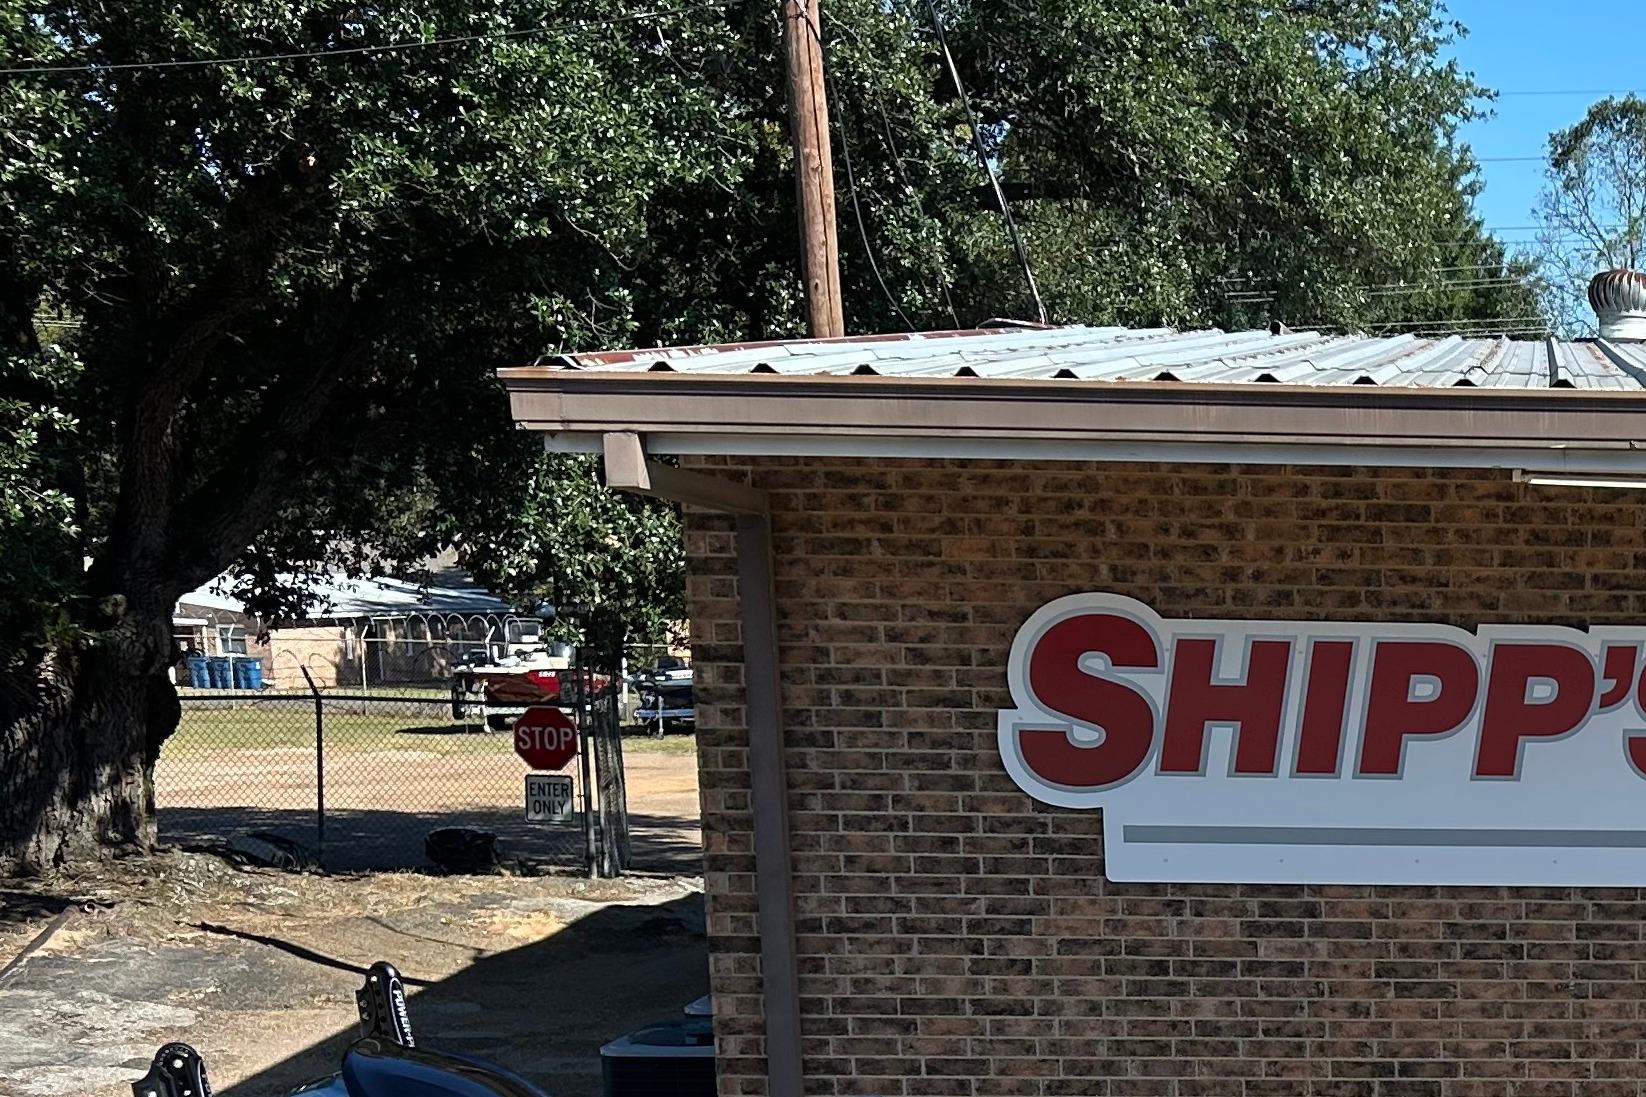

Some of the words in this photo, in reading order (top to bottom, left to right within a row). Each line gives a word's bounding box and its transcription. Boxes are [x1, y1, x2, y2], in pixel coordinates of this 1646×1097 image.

[518, 726, 573, 751] STOP
[529, 782, 570, 798] ENTER
[533, 799, 567, 815] ONLY
[392, 989, 416, 1048] POWER-P
